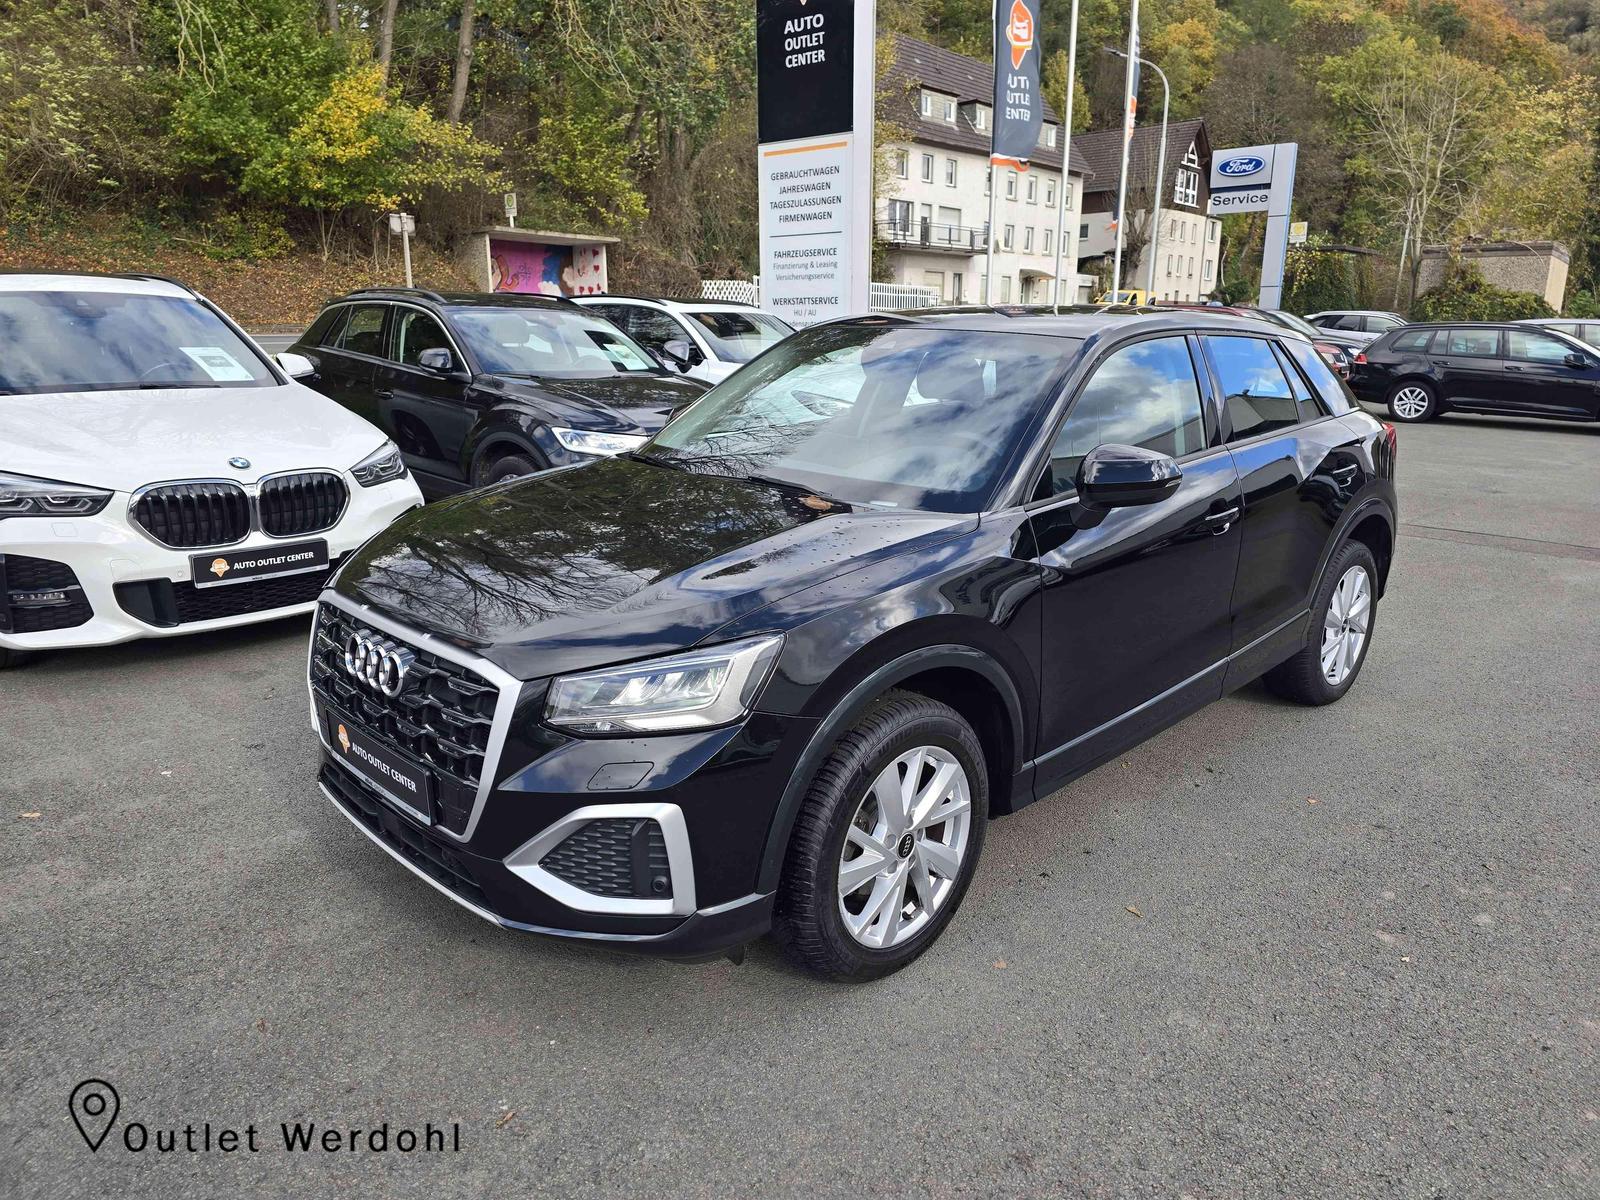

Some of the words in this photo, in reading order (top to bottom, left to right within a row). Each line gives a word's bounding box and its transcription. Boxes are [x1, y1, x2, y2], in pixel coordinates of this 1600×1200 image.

[784, 13, 825, 35] AUTO
[784, 31, 826, 52] OUTLET
[785, 49, 826, 69] CENTER
[770, 165, 840, 181] GEBRAUCHTWAGEN
[1226, 159, 1256, 173] Ford
[778, 181, 831, 195] JAHRESWAGEN
[769, 195, 842, 210] TAGESZULASSUNGEN
[1212, 193, 1269, 207] Service
[778, 211, 833, 223] FIRMENWAGEN
[773, 247, 838, 259] FAHRZEUGSERVICE
[773, 262, 809, 271] Finanzierung
[809, 261, 815, 269] &
[816, 260, 838, 269] Leasing
[775, 271, 835, 282] Versicherungsservice
[772, 296, 839, 306] WERKSTATTSERVICE
[233, 560, 256, 571] AUTO
[257, 556, 286, 567] OUTLET
[286, 551, 315, 562] CENTER
[352, 742, 368, 761] AUTO
[367, 753, 391, 777] OUTLET
[391, 768, 417, 793] CENTER
